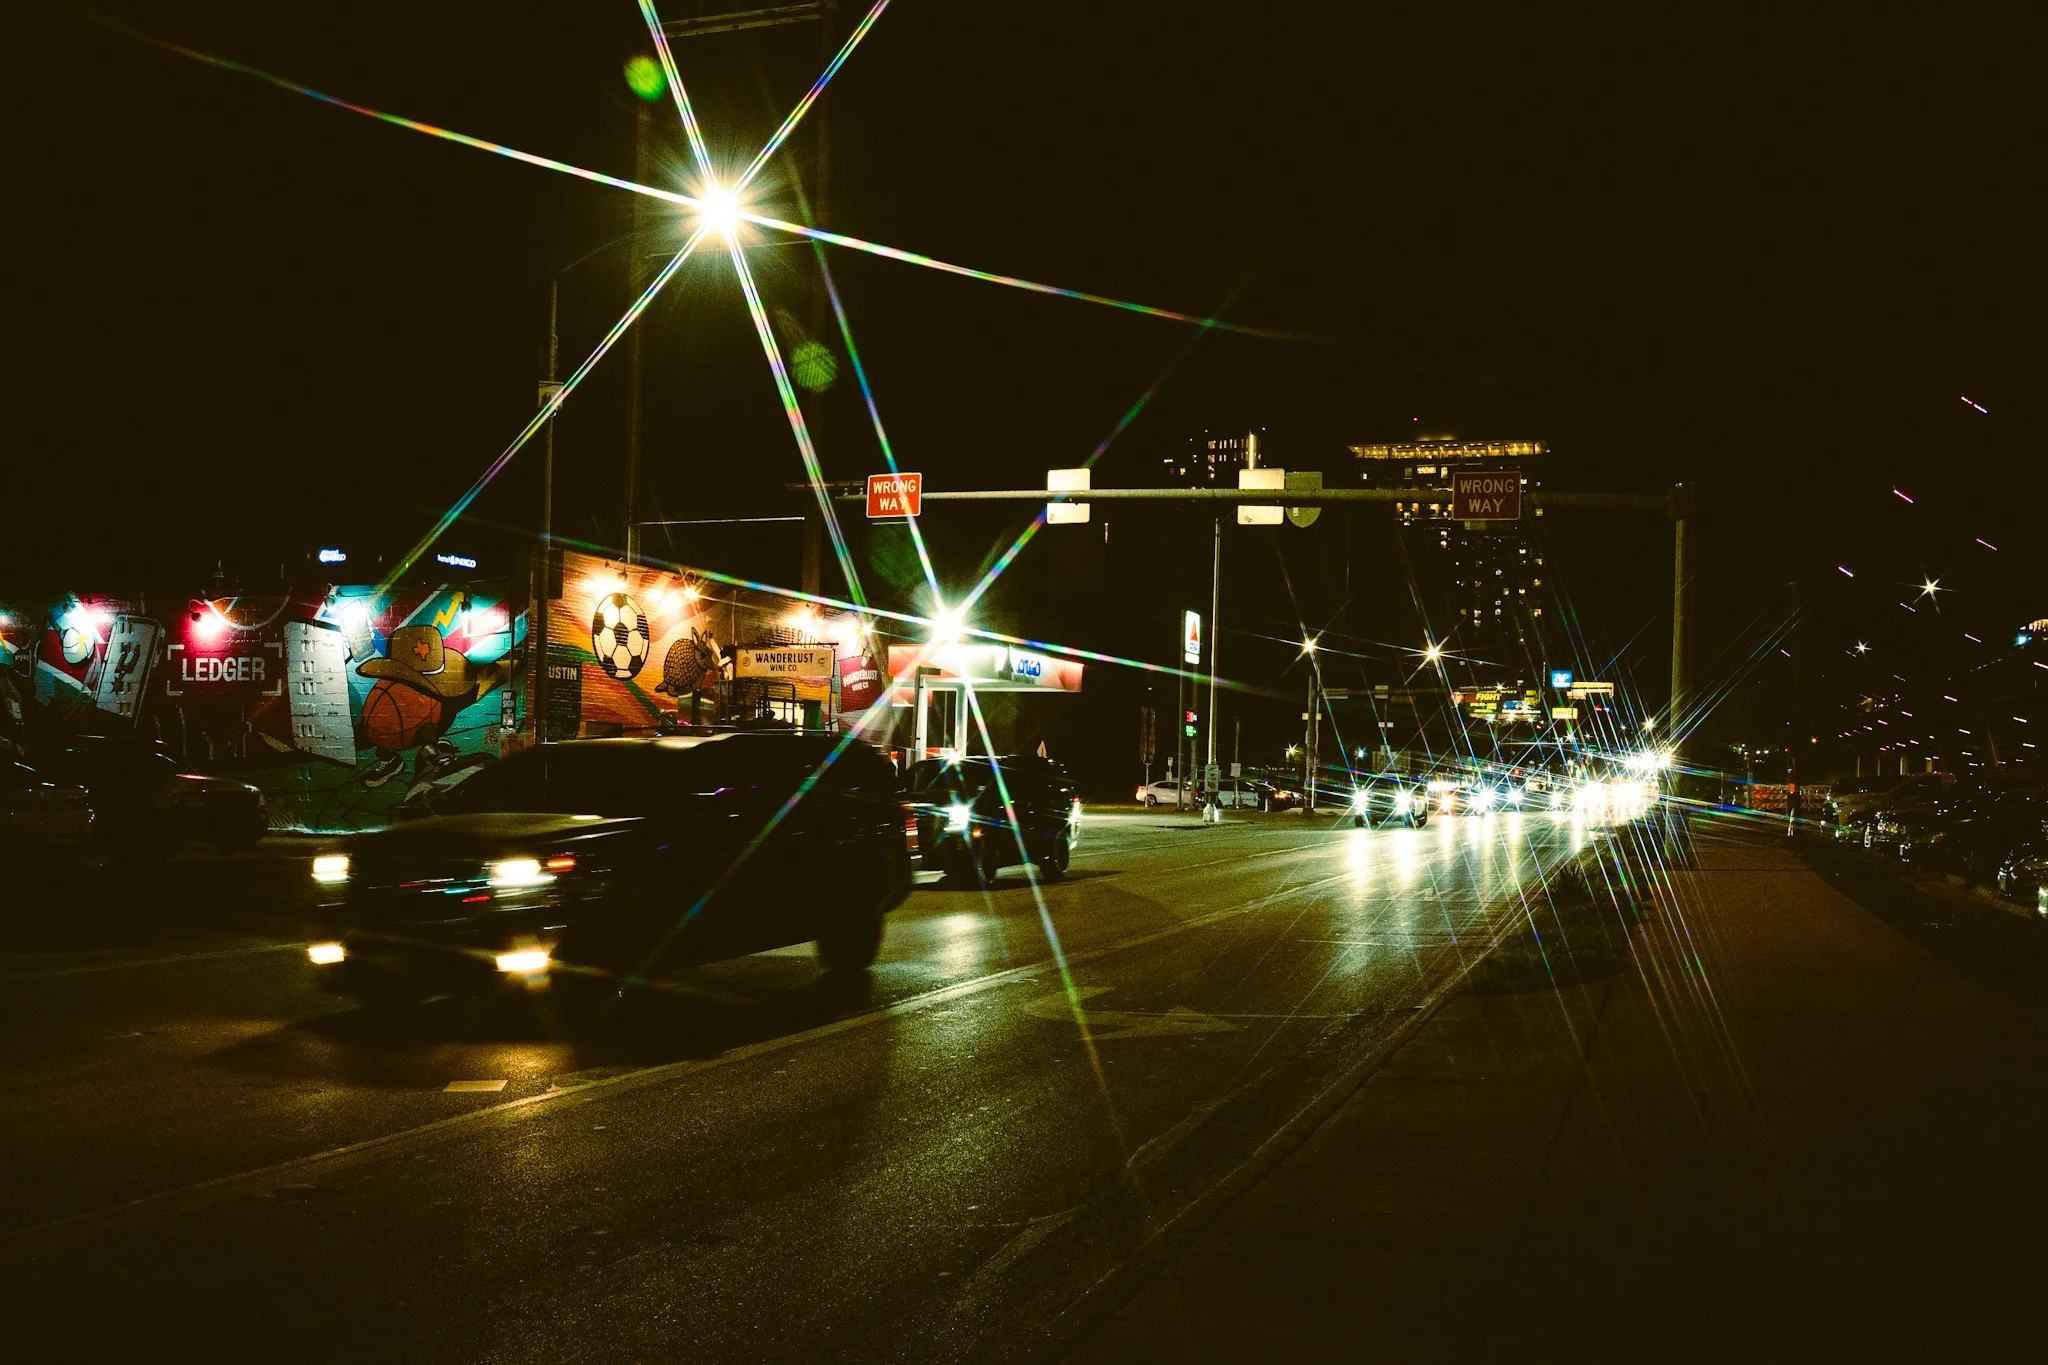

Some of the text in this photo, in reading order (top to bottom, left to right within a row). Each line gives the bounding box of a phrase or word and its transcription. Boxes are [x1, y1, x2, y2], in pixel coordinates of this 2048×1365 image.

[873, 480, 916, 494] WRONG
[1460, 479, 1514, 494] WRONG
[880, 497, 908, 511] WAY
[1469, 498, 1504, 513] WAY
[755, 652, 815, 664] WANDERLUST
[182, 657, 266, 682] LEDGER
[548, 665, 578, 680] USTIN
[769, 664, 799, 672] WINE CO.
[842, 669, 878, 688] WANDERLUST
